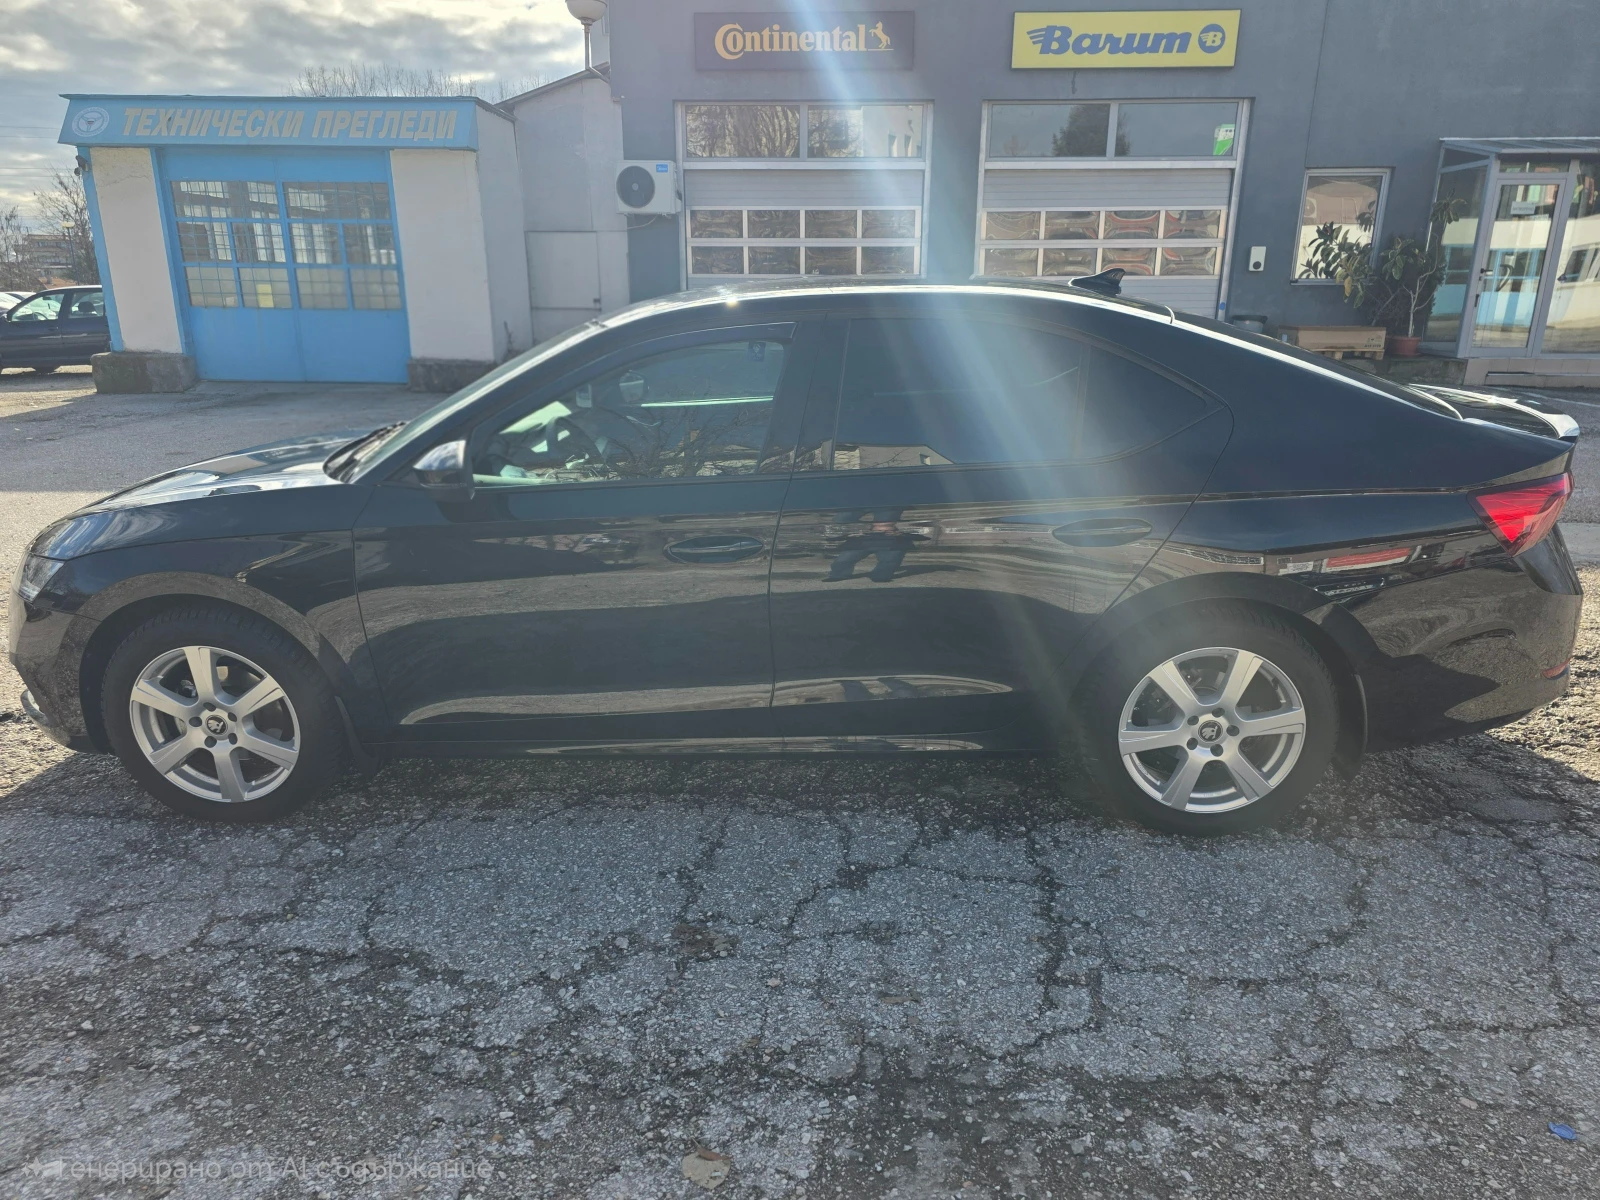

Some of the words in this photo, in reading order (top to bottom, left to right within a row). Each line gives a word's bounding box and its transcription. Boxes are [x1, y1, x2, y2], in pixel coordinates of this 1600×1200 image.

[714, 22, 868, 60] Continental
[1026, 25, 1192, 55] Barum
[122, 107, 304, 137] ТЕХНИЧЕСКИ
[311, 110, 457, 141] ПРЕГЛЕДИ
